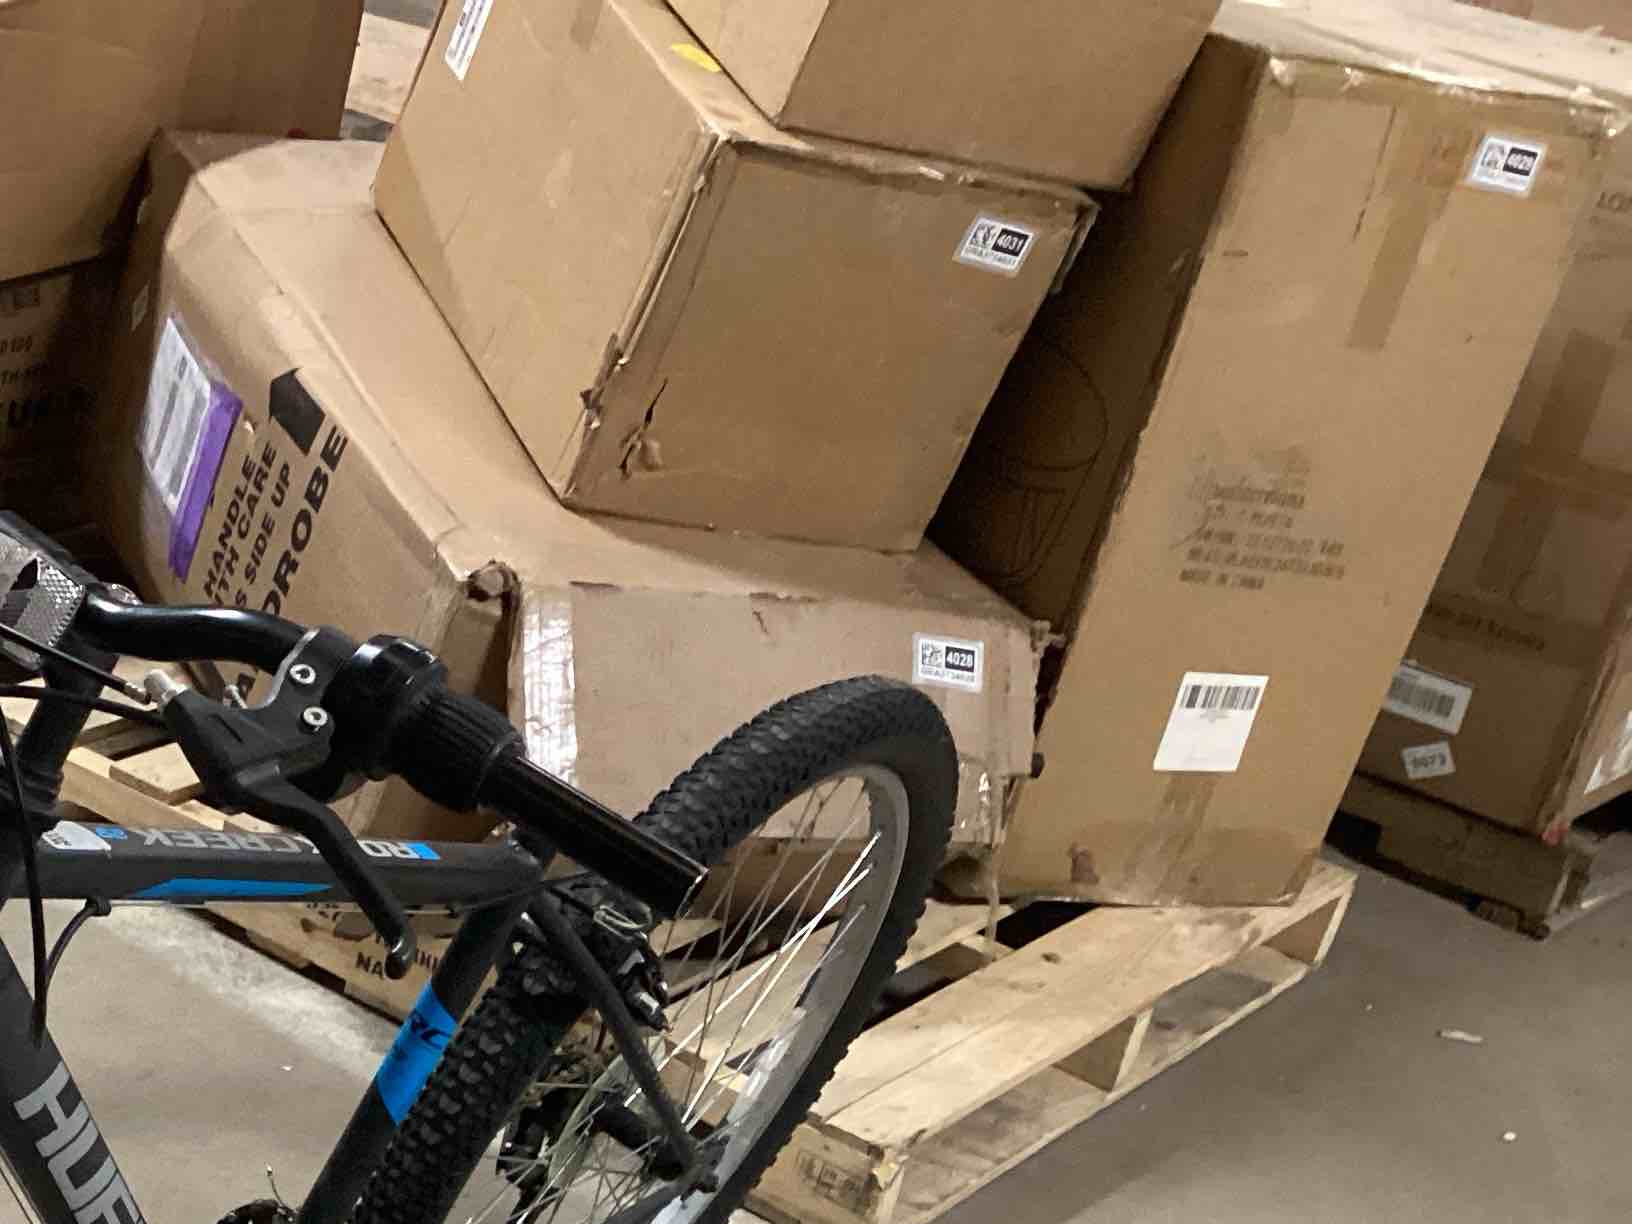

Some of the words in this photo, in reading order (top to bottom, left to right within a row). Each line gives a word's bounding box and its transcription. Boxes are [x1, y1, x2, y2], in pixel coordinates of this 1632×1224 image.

[997, 233, 1025, 254] 4031
[204, 455, 256, 598] HANDLE
[237, 441, 277, 540] CARE
[244, 512, 276, 585] SIDE
[270, 463, 290, 508] UP
[136, 830, 302, 853] CREEK
